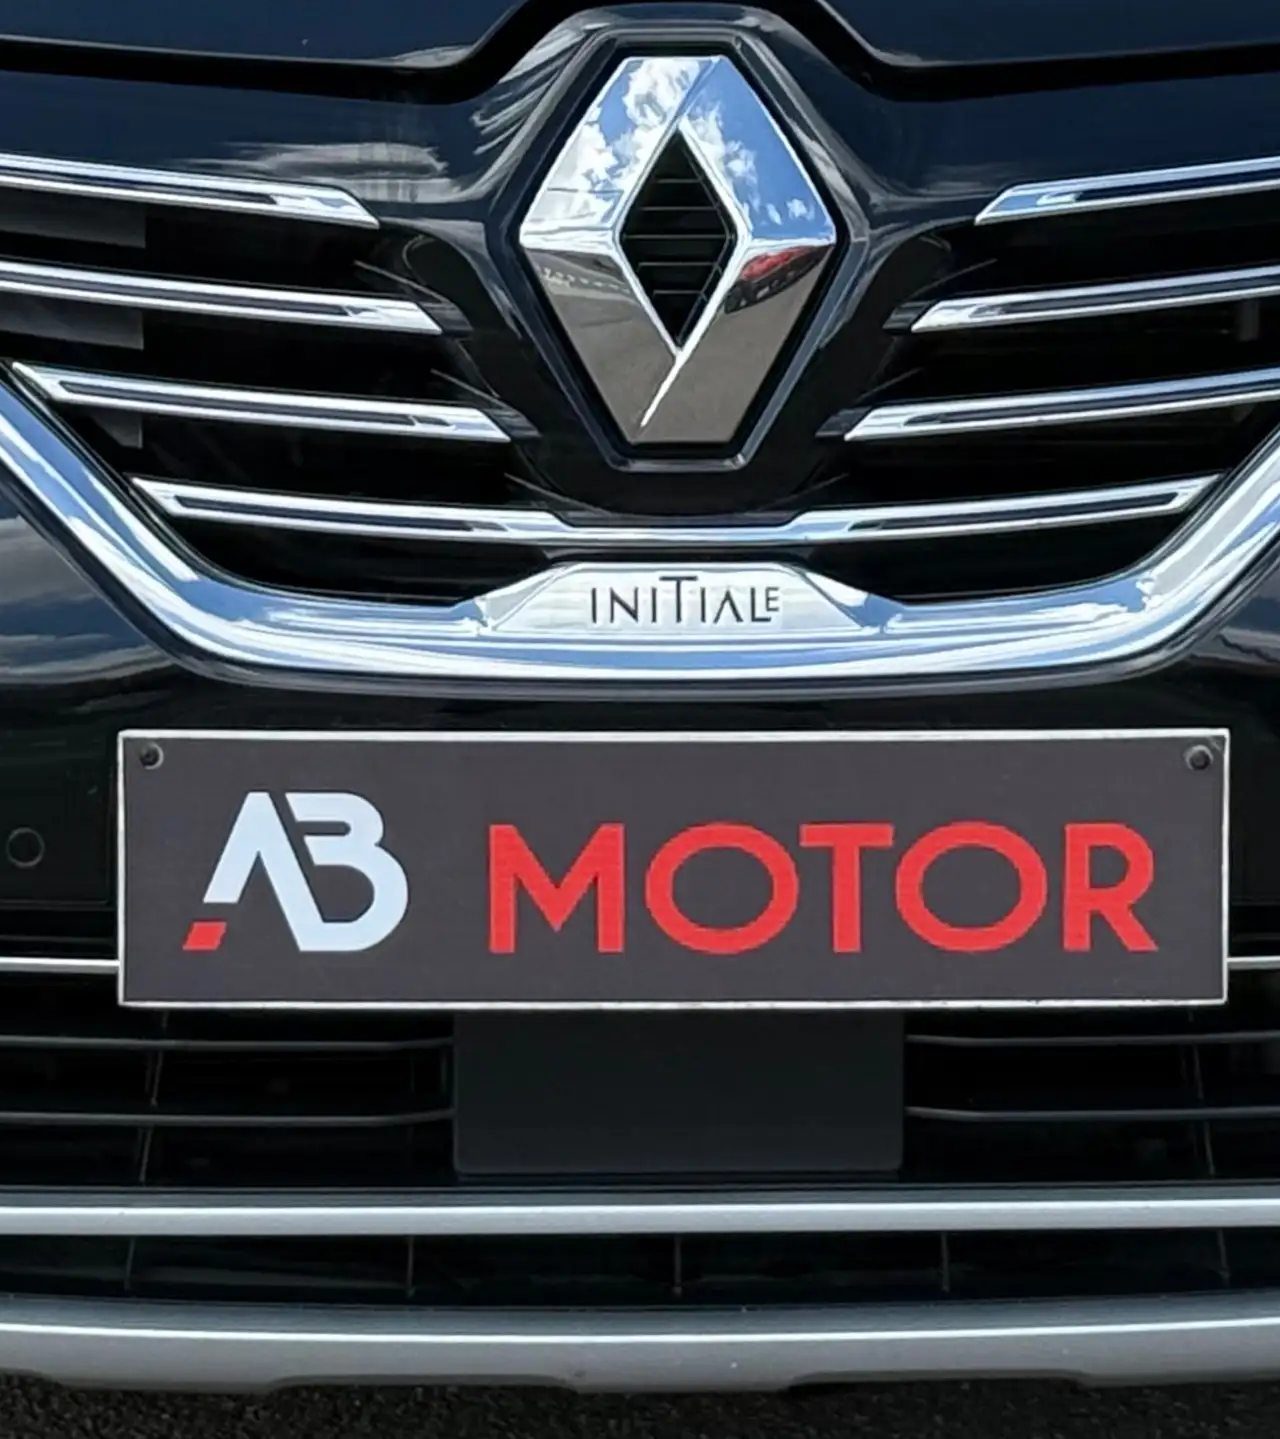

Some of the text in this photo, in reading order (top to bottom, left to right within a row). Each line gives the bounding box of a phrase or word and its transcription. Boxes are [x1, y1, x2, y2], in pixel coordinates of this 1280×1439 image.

[590, 574, 780, 624] INITIALE
[183, 791, 1159, 954] AB MOTOR
